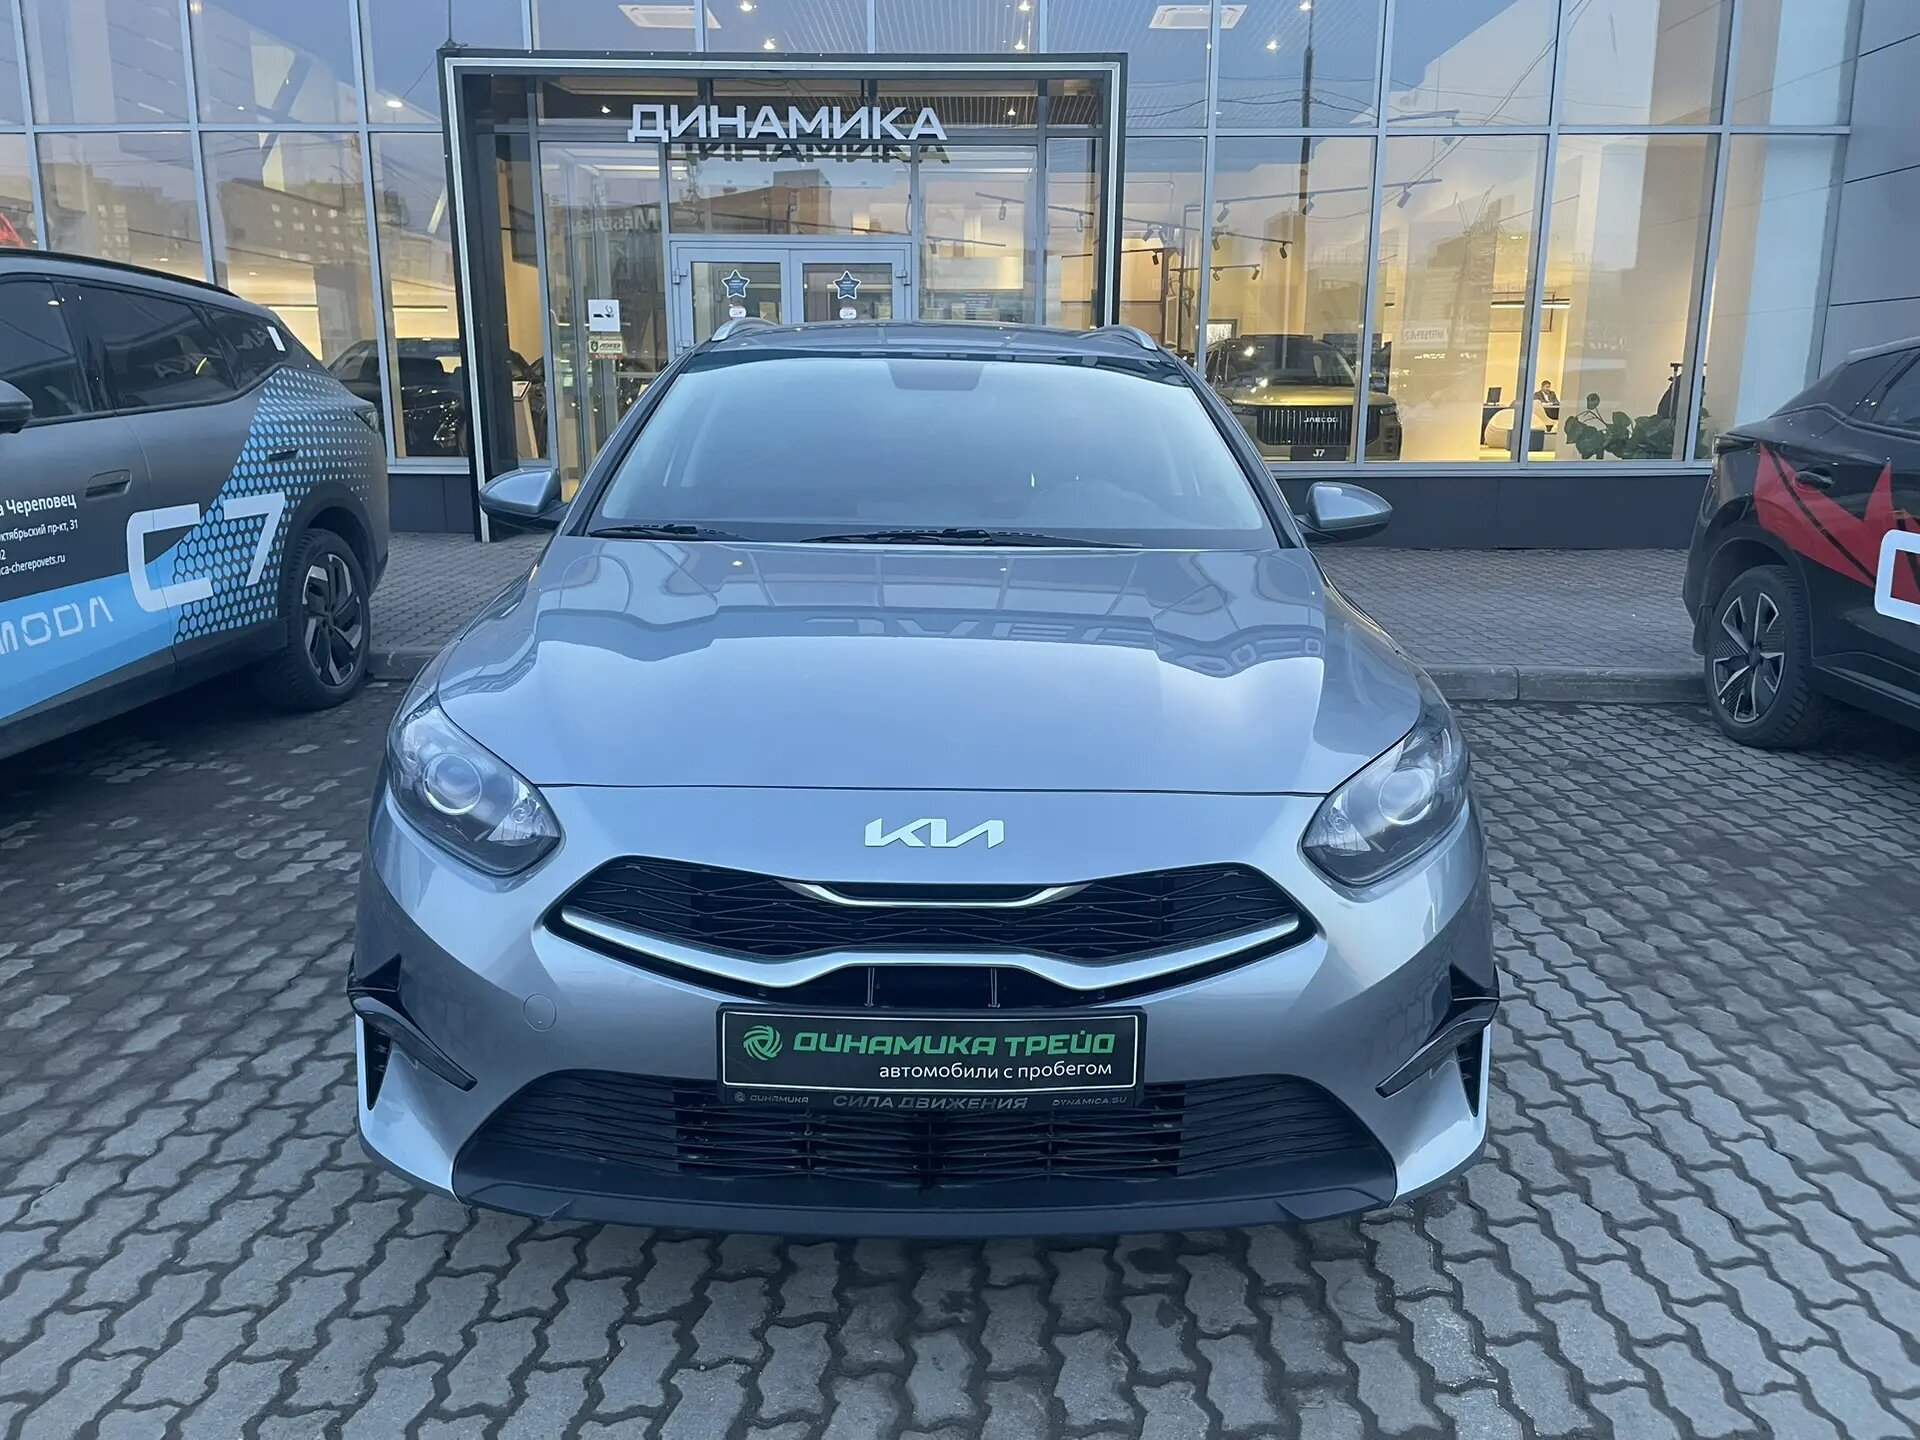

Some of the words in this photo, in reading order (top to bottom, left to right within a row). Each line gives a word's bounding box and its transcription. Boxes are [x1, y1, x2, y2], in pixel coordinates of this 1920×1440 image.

[627, 104, 948, 143] ДИНАМИКА
[1312, 449, 1326, 457] J7
[6, 493, 77, 517] Череповец
[70, 518, 78, 530] 31
[127, 492, 286, 612] C7
[864, 817, 1005, 849] KIA
[793, 1032, 997, 1056] ДИНАМИКА
[1004, 1030, 1115, 1057] ТРЕЙД
[879, 1062, 998, 1078] автомобили
[1003, 1067, 1013, 1079] с
[1018, 1061, 1112, 1081] пробегом
[833, 1094, 893, 1108] СИЛА
[898, 1095, 1028, 1110] ДВИЖЕНИЯ
[1052, 1096, 1127, 1107] DYNAMICA.SU
